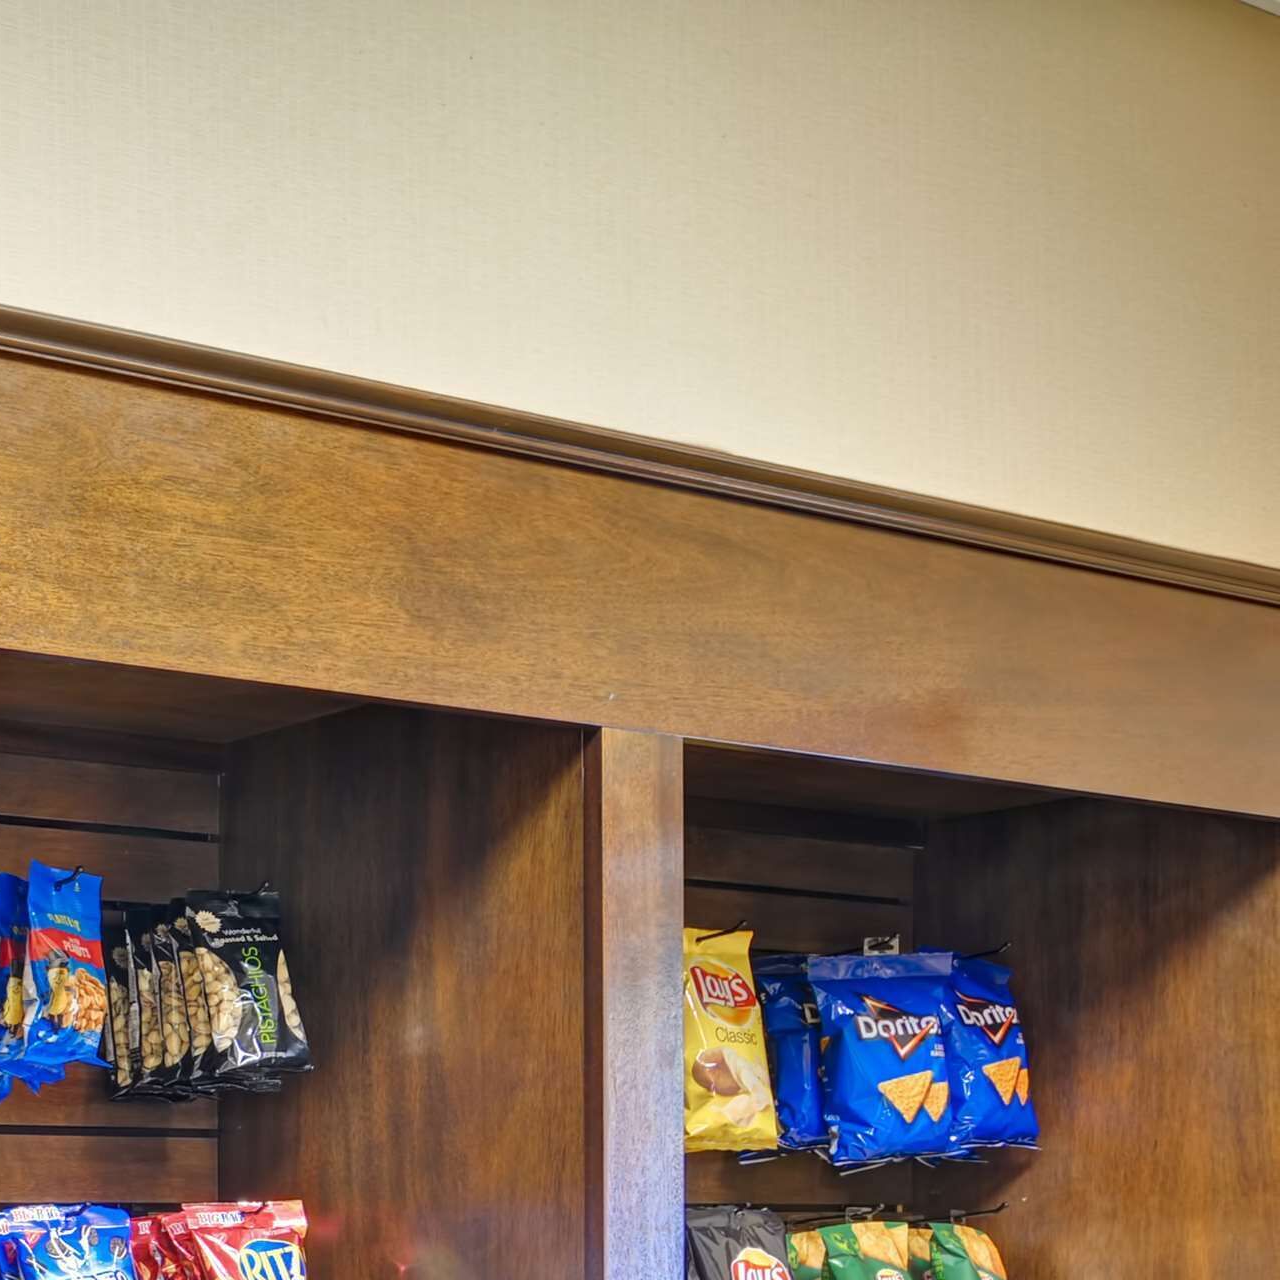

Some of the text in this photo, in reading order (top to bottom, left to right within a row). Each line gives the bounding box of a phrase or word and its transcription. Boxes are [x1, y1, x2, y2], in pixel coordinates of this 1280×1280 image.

[242, 946, 277, 1045] PISTACHIOS
[696, 969, 749, 1002] Lay's
[857, 1014, 941, 1040] Dorito
[956, 1003, 1020, 1026] Dorito
[714, 1026, 758, 1046] Classic
